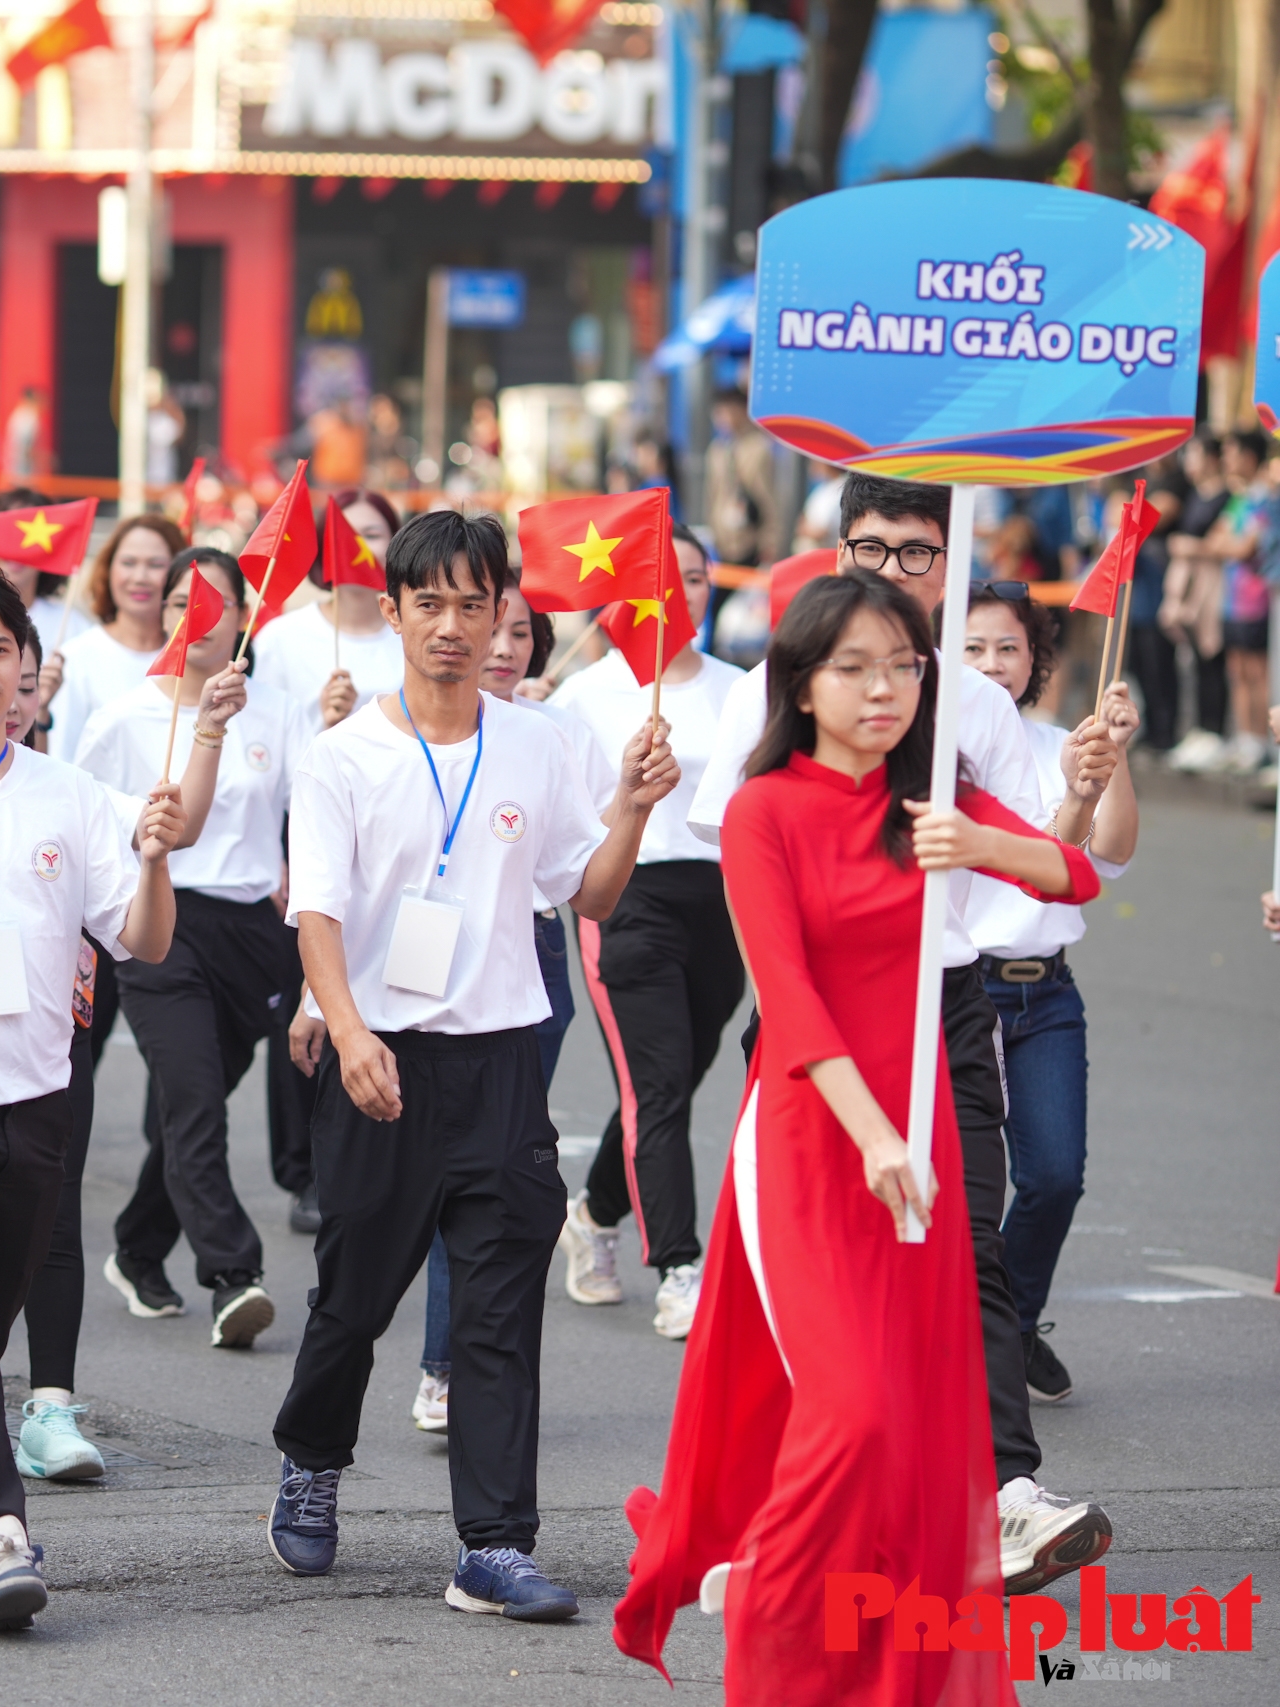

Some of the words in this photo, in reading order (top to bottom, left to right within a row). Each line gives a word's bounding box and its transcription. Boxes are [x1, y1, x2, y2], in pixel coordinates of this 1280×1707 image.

[918, 251, 1044, 304] KHỐI
[779, 303, 944, 355] NGÀNH
[951, 312, 1073, 360] GIÁO
[1079, 325, 1176, 375] DỤC
